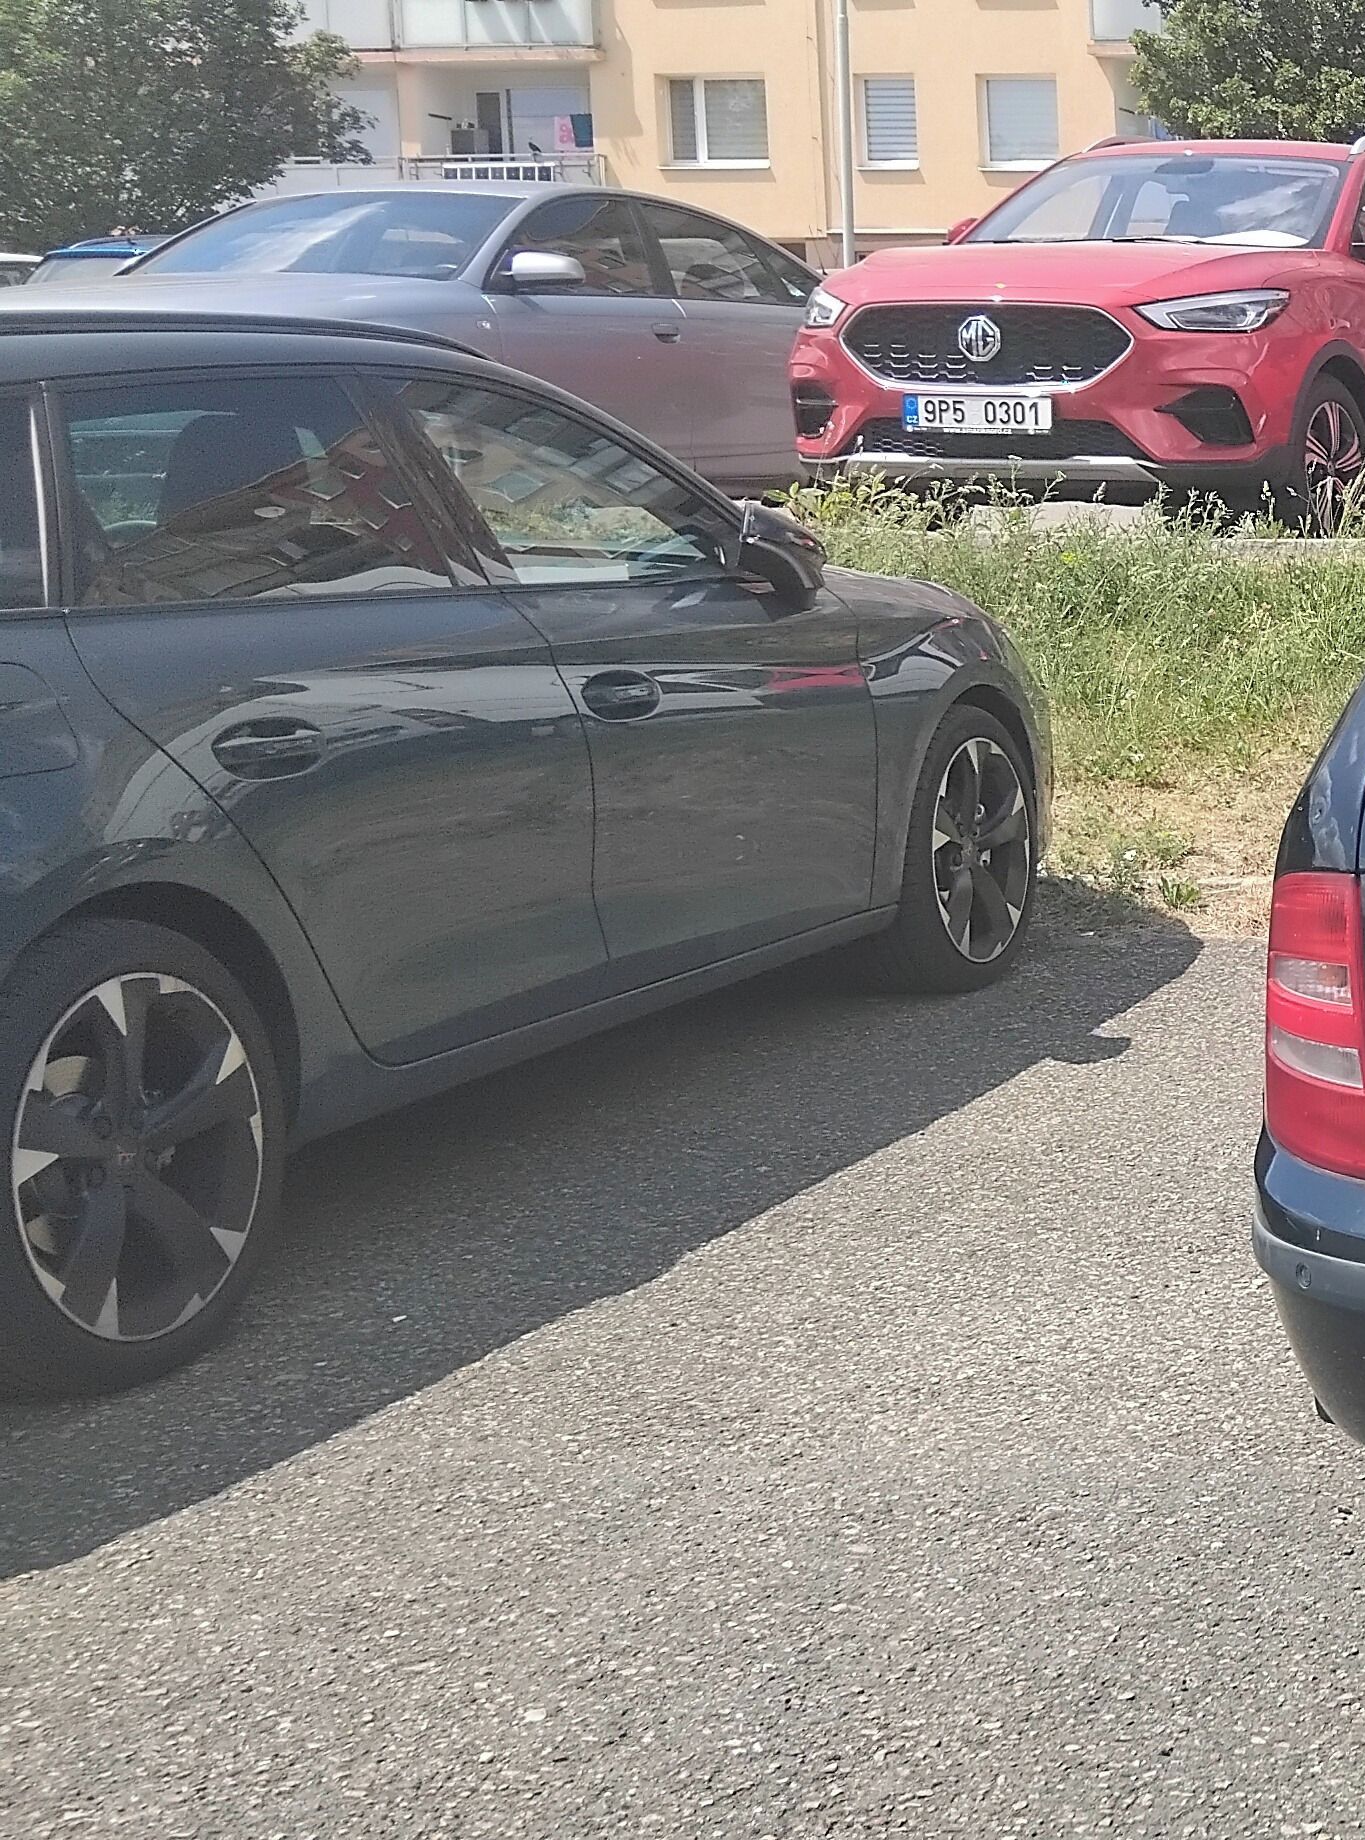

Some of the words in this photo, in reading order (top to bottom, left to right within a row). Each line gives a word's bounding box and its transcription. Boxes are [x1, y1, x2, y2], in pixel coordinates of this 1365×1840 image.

[961, 320, 995, 357] MG
[906, 415, 919, 423] CZ
[924, 400, 965, 424] 9P5
[984, 400, 1040, 426] 0301
